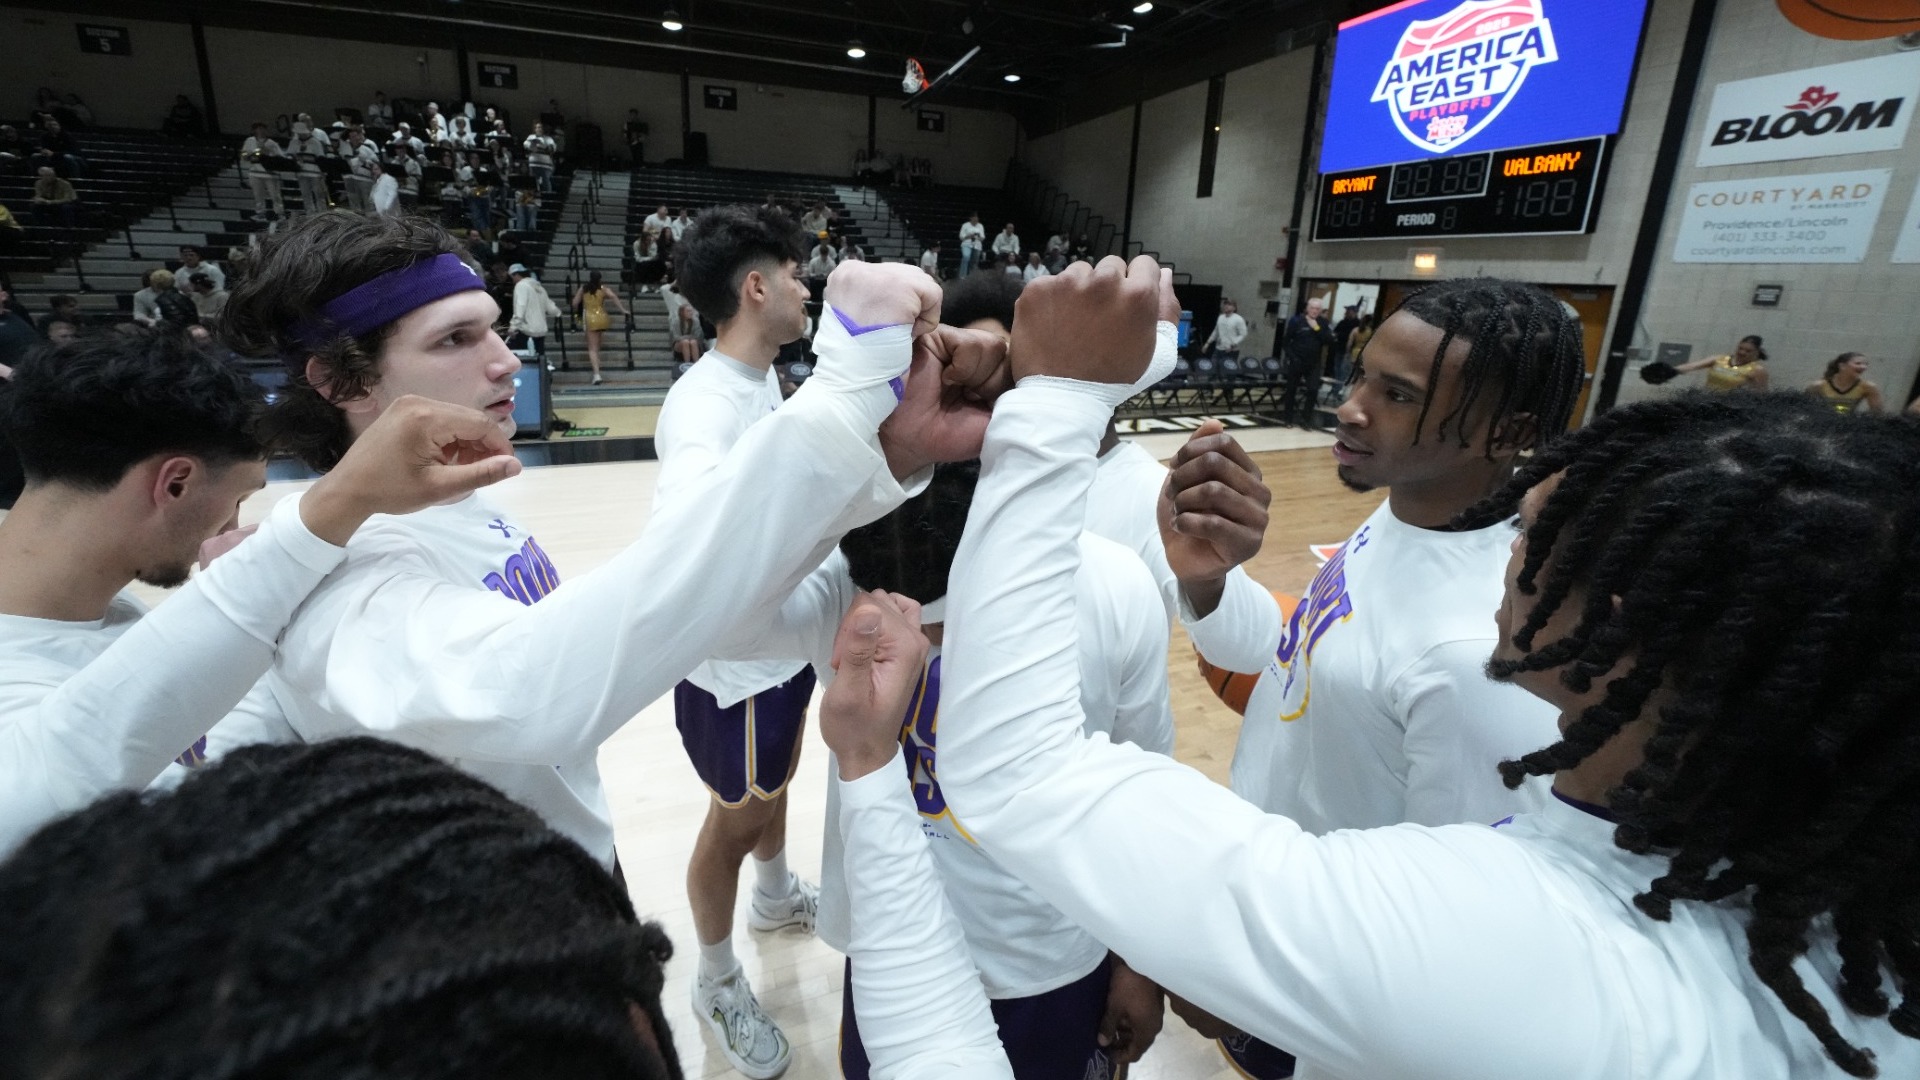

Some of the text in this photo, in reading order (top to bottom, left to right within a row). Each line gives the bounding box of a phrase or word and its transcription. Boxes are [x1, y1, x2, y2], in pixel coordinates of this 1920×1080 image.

[100, 38, 111, 52] 5
[1381, 26, 1546, 95] AMERICA
[494, 74, 503, 87] 6
[1409, 65, 1501, 107] EAST
[1409, 95, 1492, 122] PLAYOFFS
[1710, 97, 1906, 147] BLOOM
[1332, 175, 1377, 195] BRYANT
[1694, 183, 1872, 208] COURTYARD
[1396, 212, 1436, 227] PERIOD
[1703, 216, 1848, 230] Providence/Lincoln
